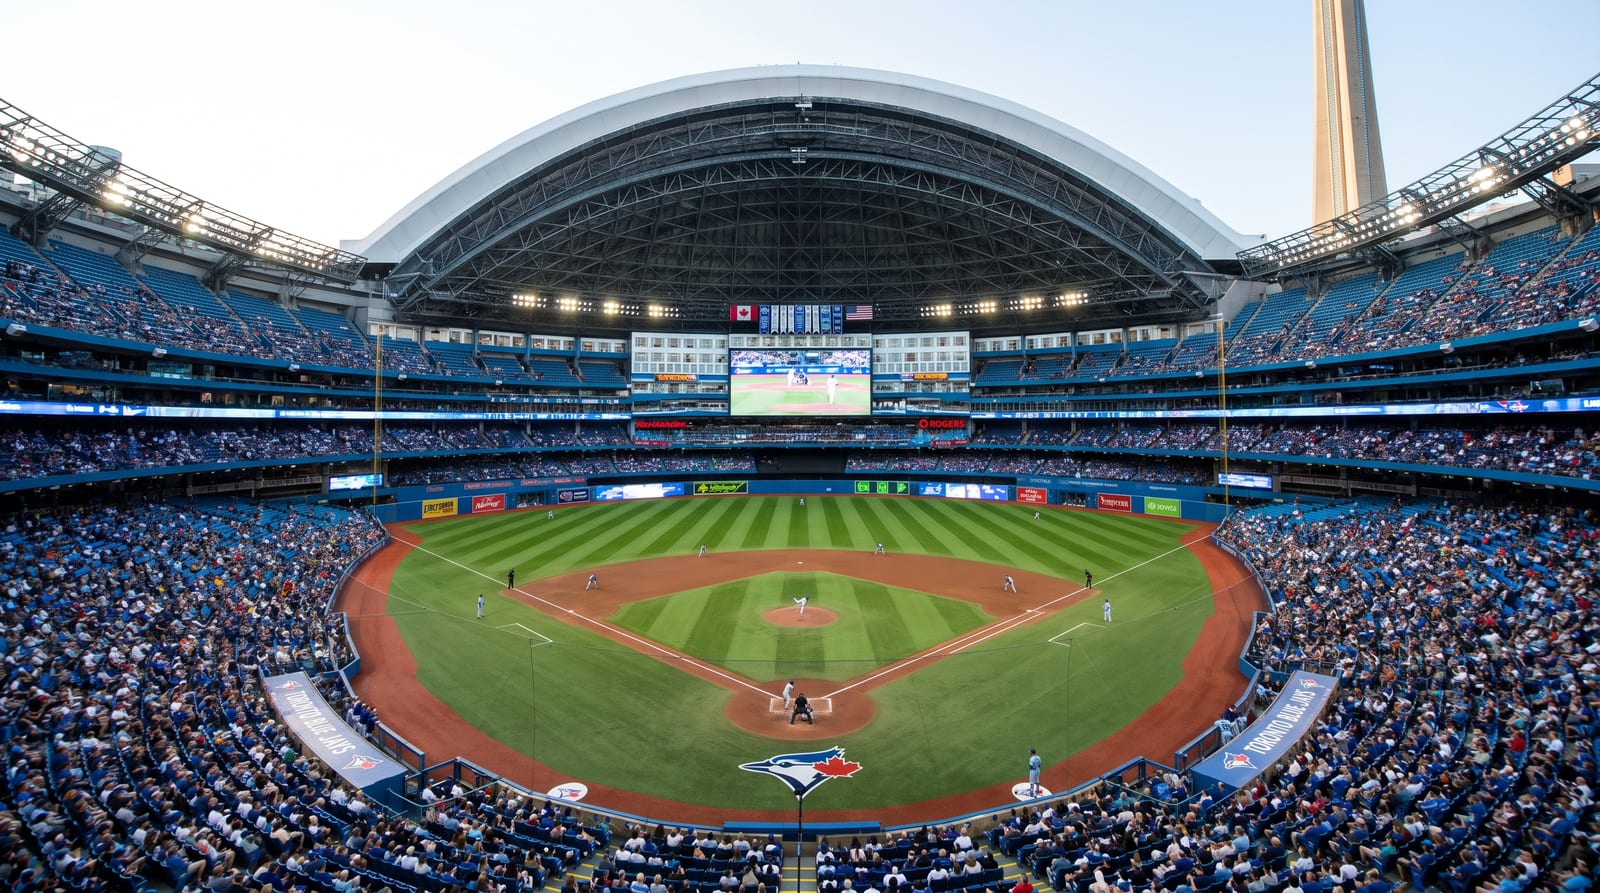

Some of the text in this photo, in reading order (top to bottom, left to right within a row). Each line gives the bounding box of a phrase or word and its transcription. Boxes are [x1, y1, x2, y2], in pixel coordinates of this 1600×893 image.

[930, 419, 965, 429] ROGERS
[303, 717, 337, 736] BLUE
[1243, 689, 1316, 754] TORONTO BLUE JAYS
[318, 734, 356, 754] JAYS
